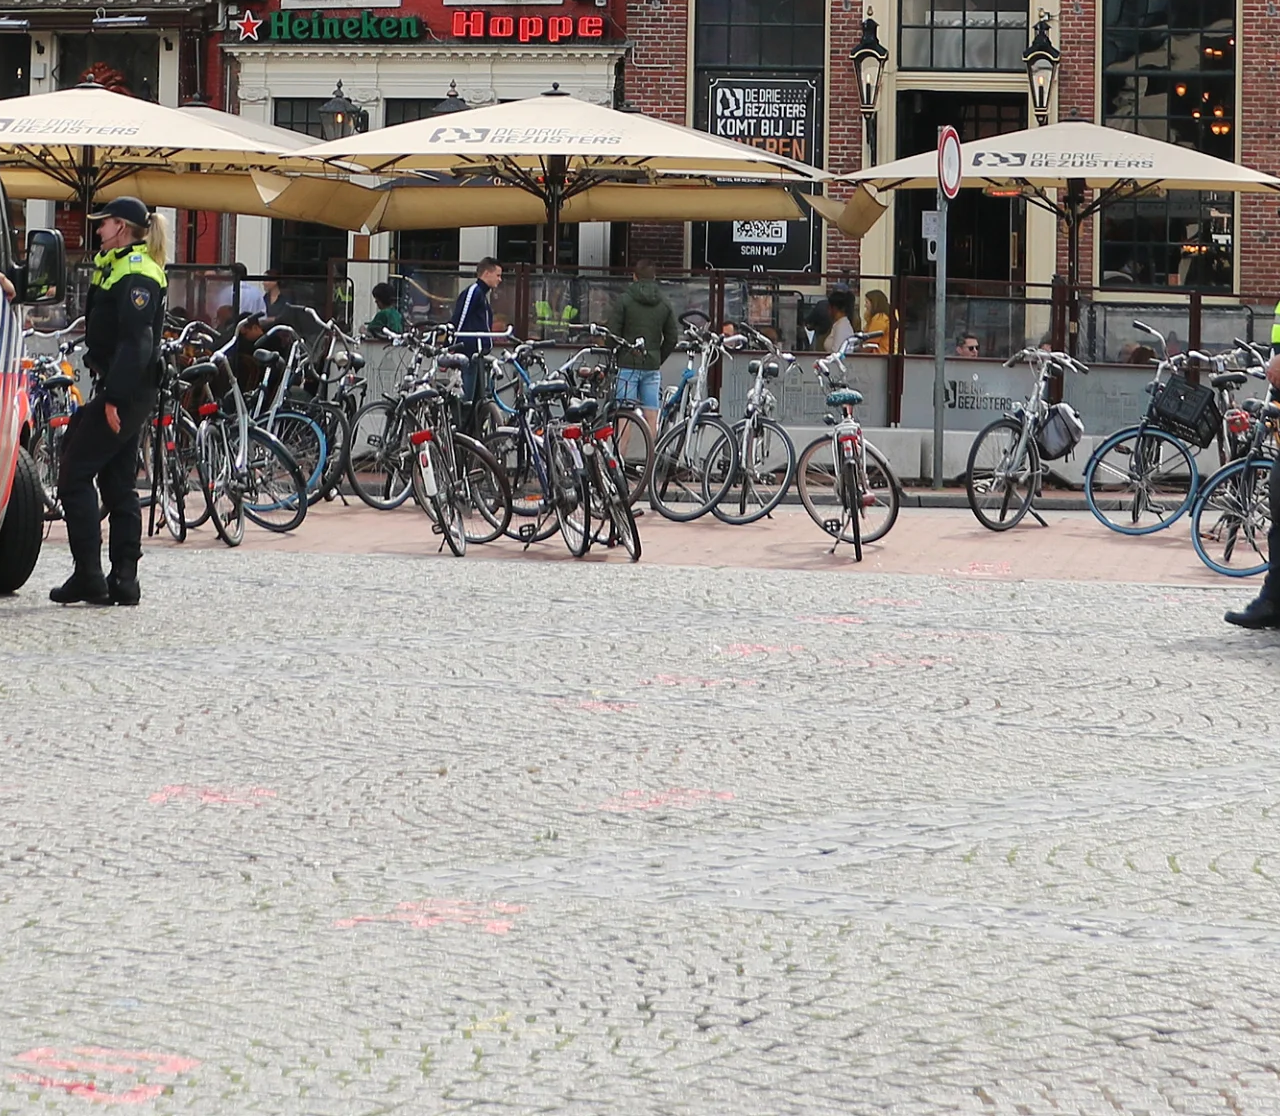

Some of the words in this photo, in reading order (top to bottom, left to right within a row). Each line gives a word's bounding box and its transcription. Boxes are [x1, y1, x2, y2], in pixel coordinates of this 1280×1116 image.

[269, 10, 419, 40] Heineken
[452, 10, 604, 42] Hoppe
[745, 88, 757, 103] DE
[759, 88, 781, 103] DRIE
[745, 103, 806, 118] GEZUSTERS
[717, 118, 757, 136] KOMT
[761, 119, 783, 137] BIJ
[787, 119, 805, 137] JE
[489, 135, 622, 145] GEZUSTERS
[1030, 160, 1154, 169] GEZUSTERS
[741, 245, 761, 256] SCAN
[763, 245, 777, 256] MIJ
[958, 395, 1012, 411] GEZUSTERS
